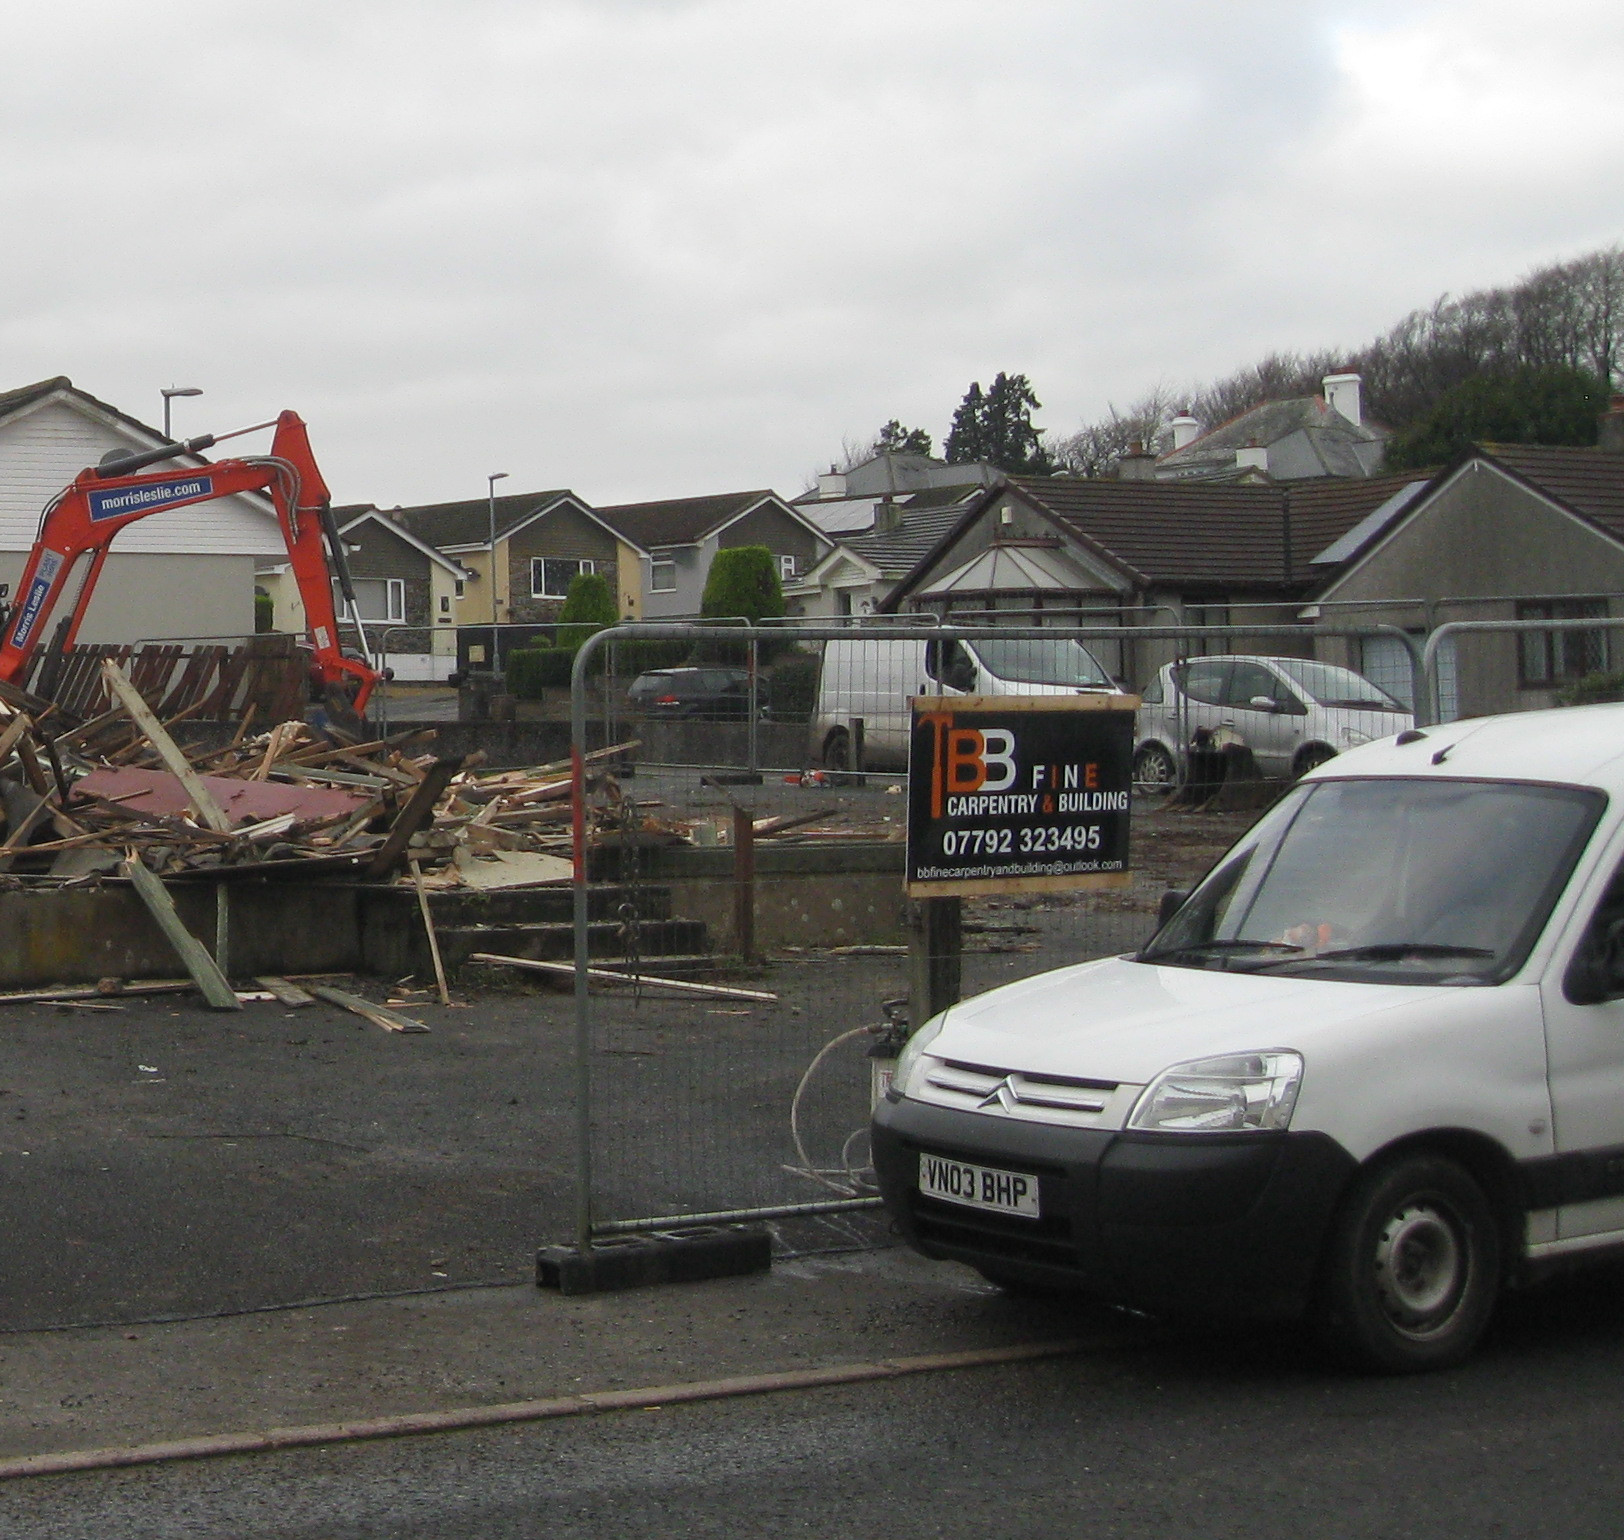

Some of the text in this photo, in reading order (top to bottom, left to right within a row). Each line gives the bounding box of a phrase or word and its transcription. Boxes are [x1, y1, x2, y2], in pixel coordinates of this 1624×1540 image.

[101, 482, 201, 510] morrisleslie.com
[16, 584, 45, 642] Morris Leslie
[1032, 763, 1099, 789] FINE
[947, 791, 1128, 816] CARPENTRY & BUILDING
[943, 825, 1100, 856] 07792 323495
[917, 859, 1123, 879] bbfinecarpentryandbuilding@outlook.com
[927, 1158, 1027, 1207] VN03 BHP
